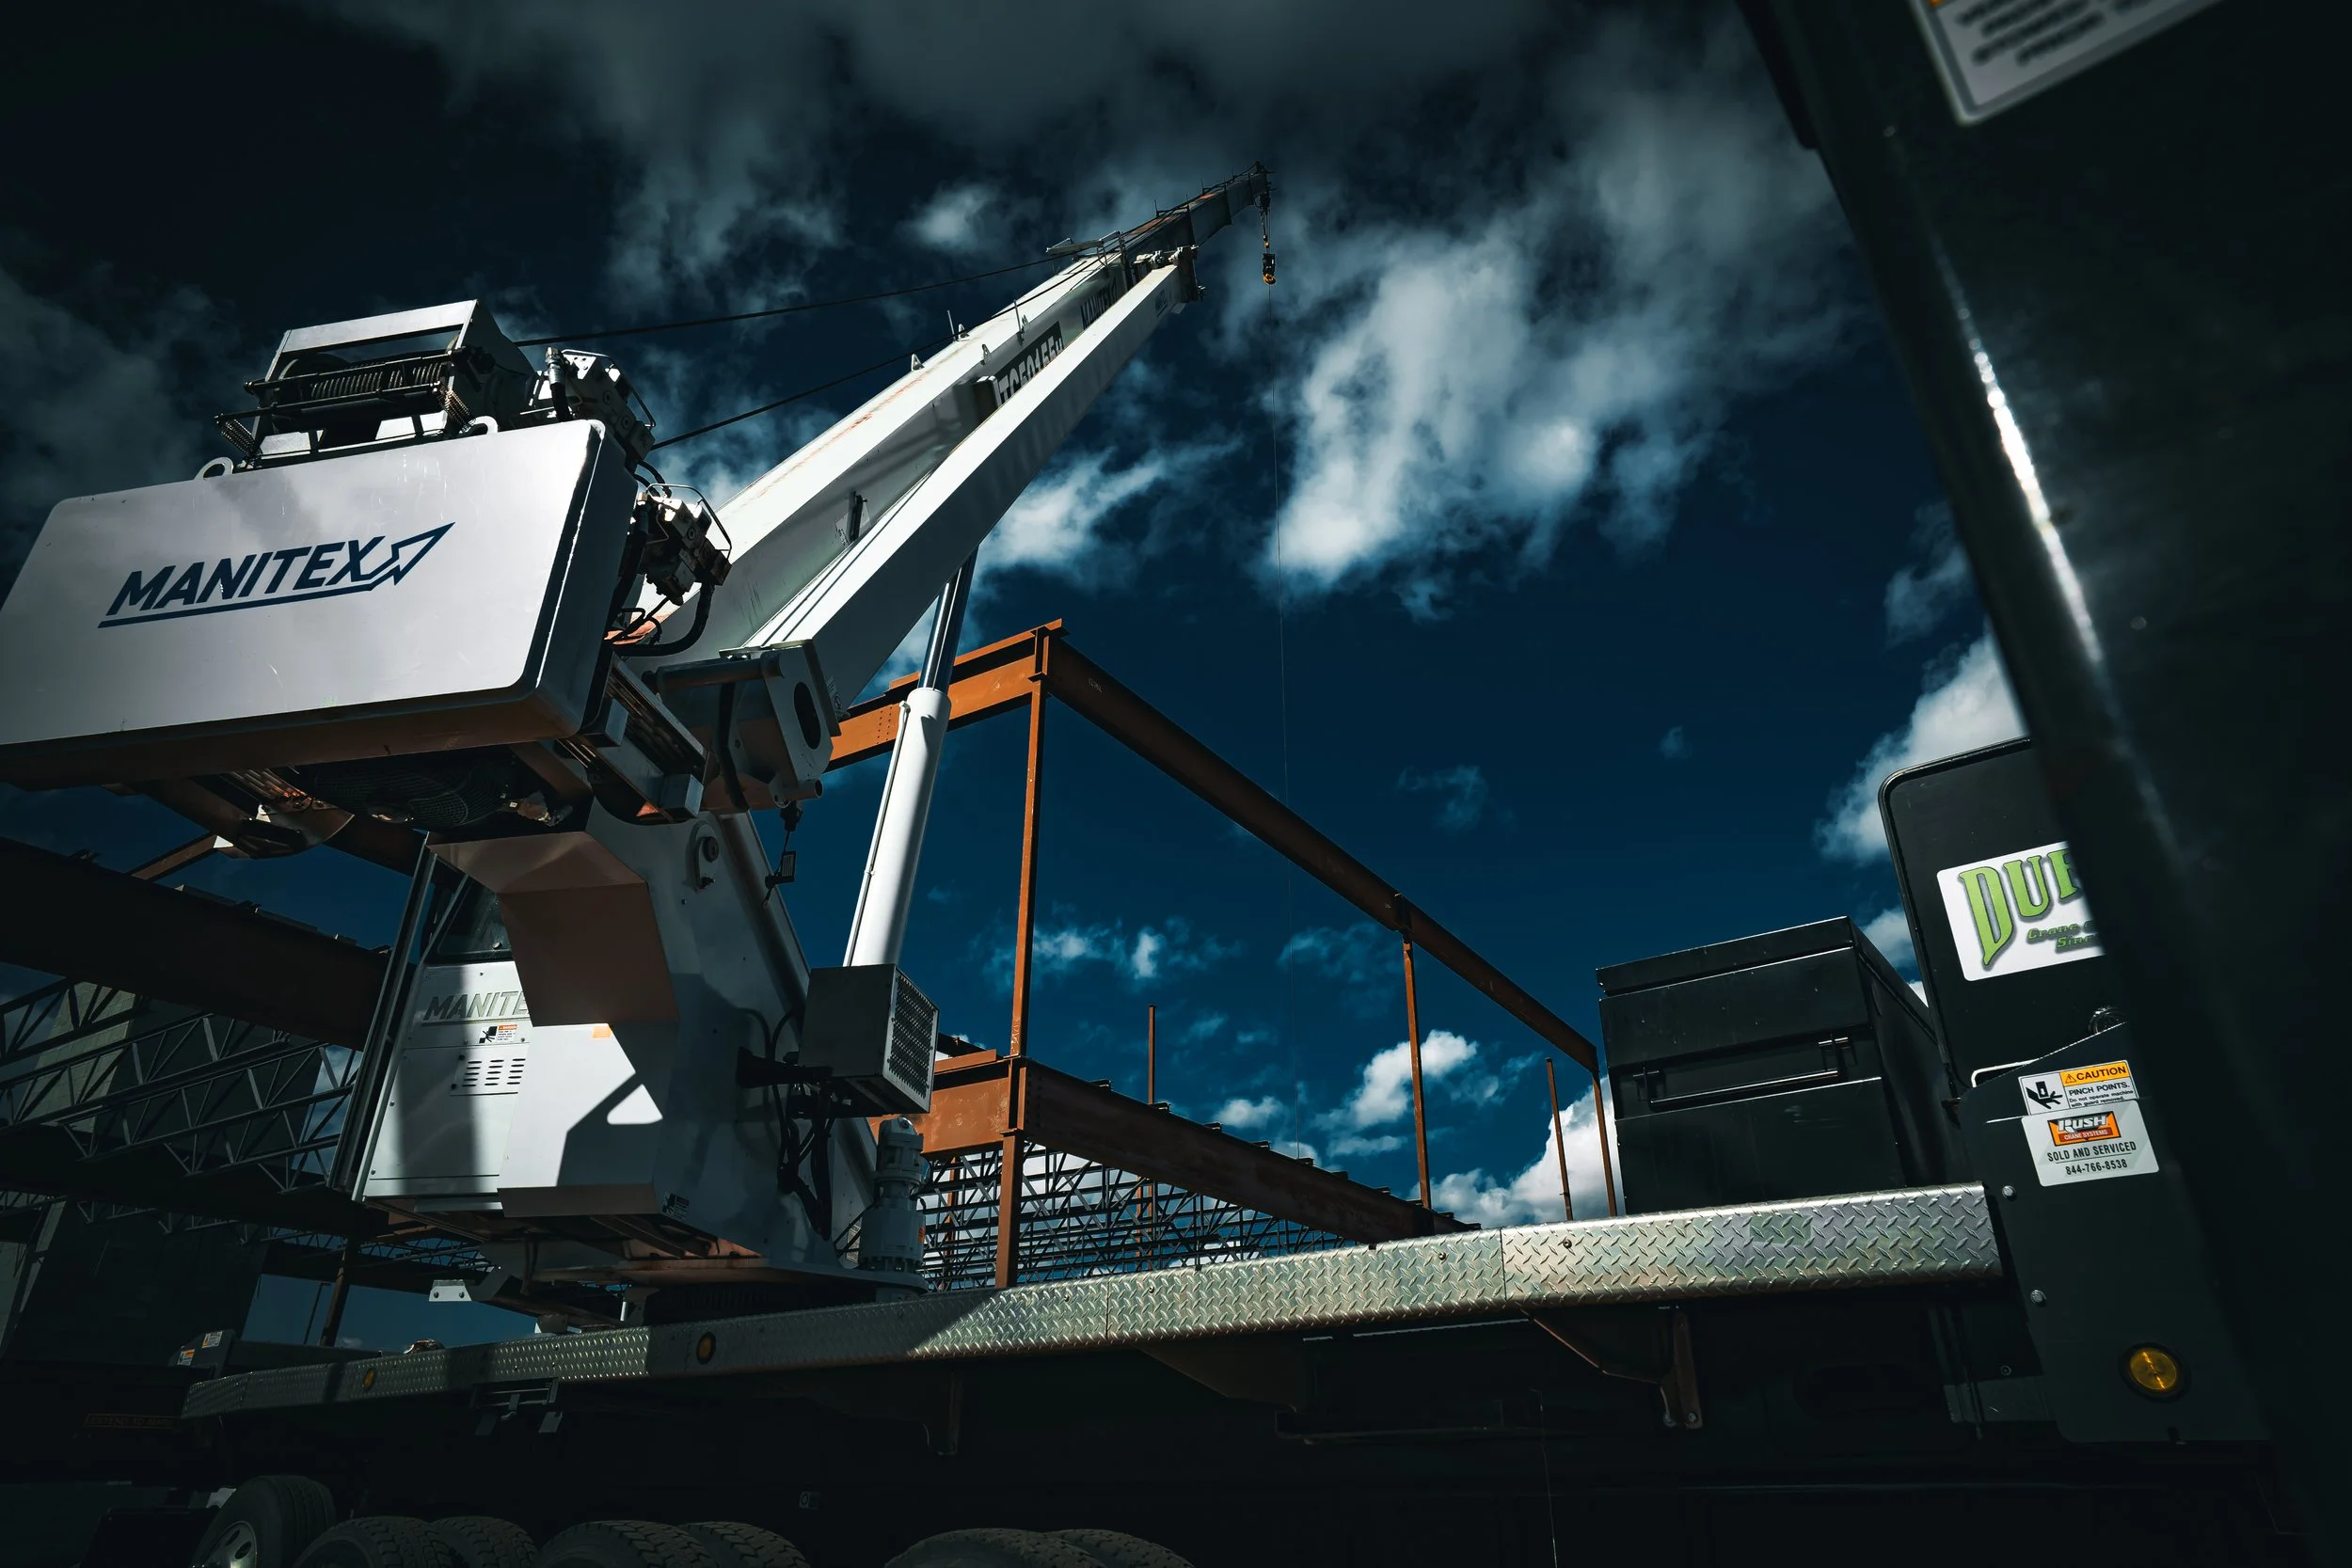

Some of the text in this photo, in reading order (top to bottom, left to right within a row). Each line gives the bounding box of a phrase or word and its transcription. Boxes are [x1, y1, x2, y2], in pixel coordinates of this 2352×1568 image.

[104, 534, 389, 617] MANITEX
[2027, 924, 2078, 940] Crane
[2057, 934, 2097, 948] Sinc
[2076, 1066, 2126, 1081] CAUTION
[2069, 1082, 2131, 1096] PINCH POINTS.
[2058, 1115, 2107, 1133] RUSH
[2047, 1141, 2137, 1162] SOLD AND SERVICED
[2065, 1159, 2128, 1175] 844-766-8538
